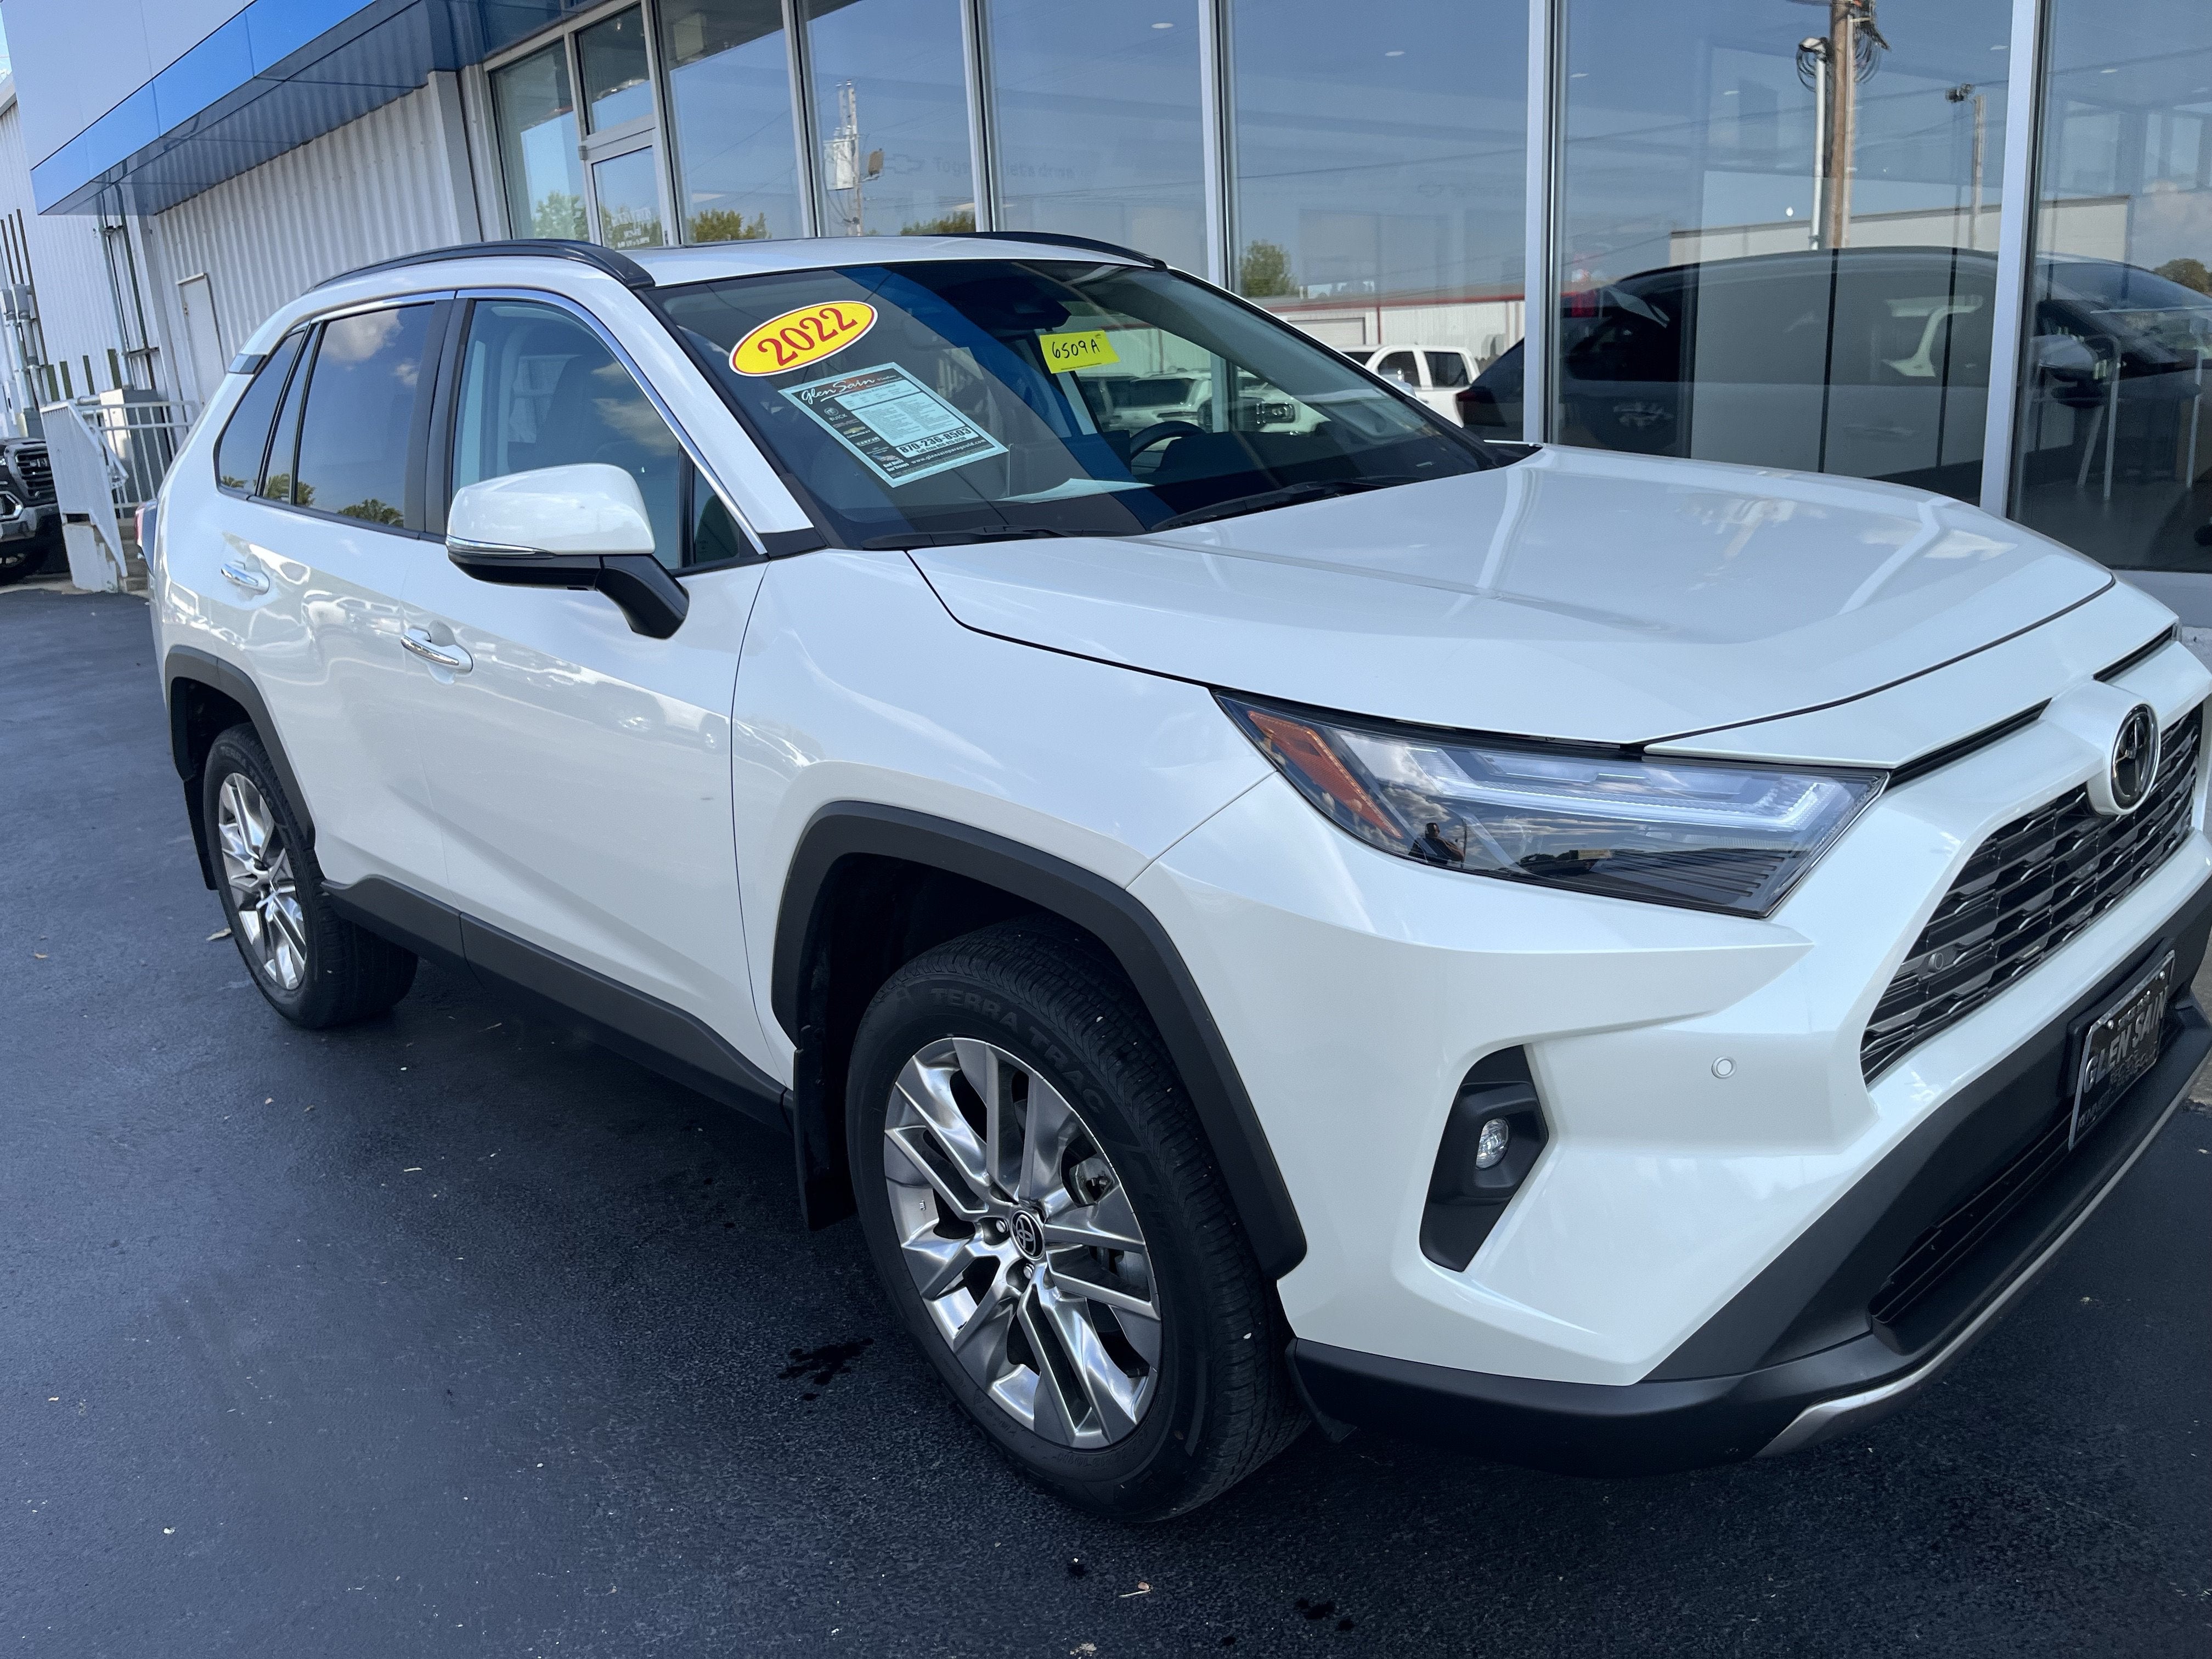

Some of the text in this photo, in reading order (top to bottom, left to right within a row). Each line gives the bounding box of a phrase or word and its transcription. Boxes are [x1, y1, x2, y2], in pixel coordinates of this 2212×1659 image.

[758, 308, 857, 366] 2022
[801, 388, 836, 405] Glen
[833, 379, 875, 393] Sain
[899, 427, 972, 454] 870-236-8503
[911, 439, 986, 465] www.glensainparagould.com
[930, 988, 1105, 1114] TERRA TRAC
[2085, 1024, 2132, 1092] GLEN
[2132, 985, 2168, 1048] SAIN
